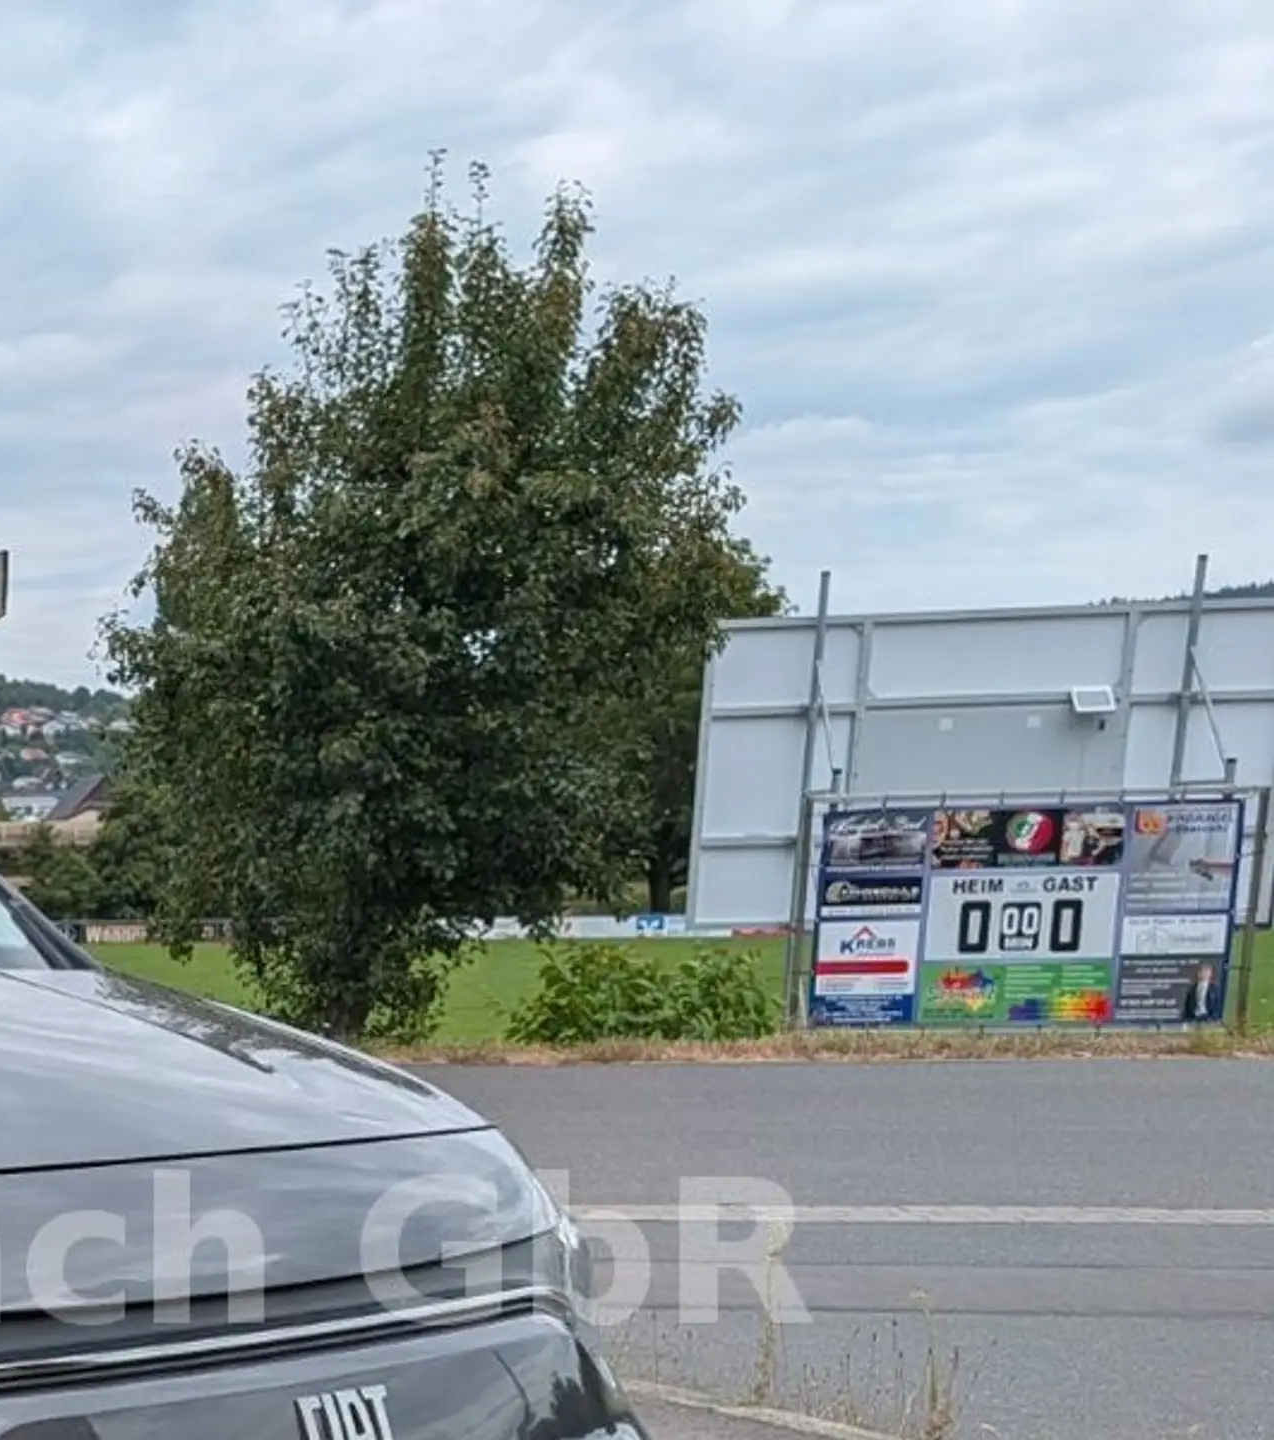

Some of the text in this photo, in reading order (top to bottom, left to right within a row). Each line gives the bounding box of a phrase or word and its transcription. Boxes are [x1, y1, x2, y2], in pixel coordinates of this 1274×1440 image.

[952, 876, 1099, 895] HEIM GAST
[958, 898, 1084, 954] 0 00 0
